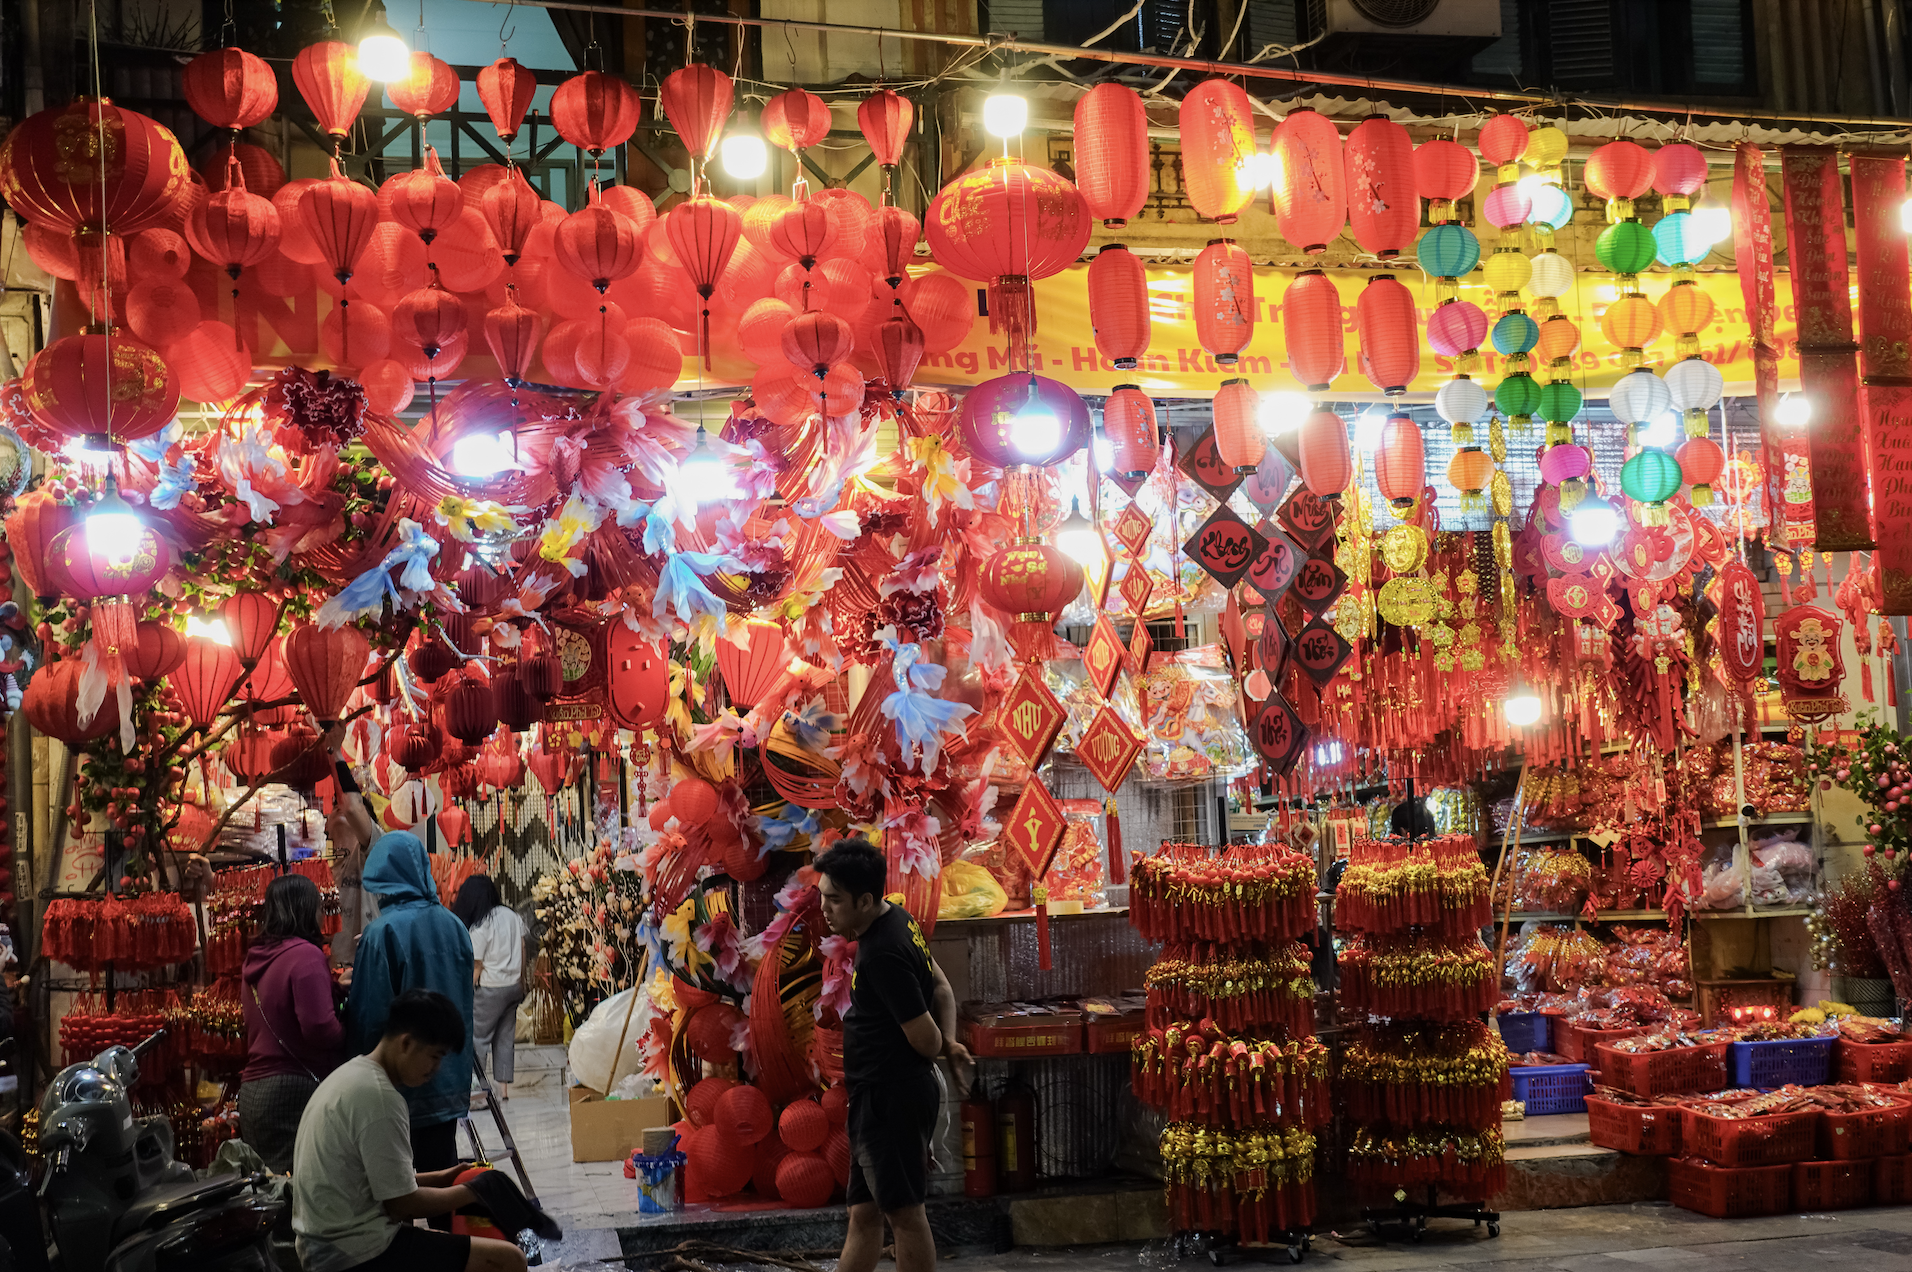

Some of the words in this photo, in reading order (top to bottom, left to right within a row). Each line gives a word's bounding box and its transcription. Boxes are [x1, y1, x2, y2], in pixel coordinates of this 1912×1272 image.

[1874, 431, 1912, 449] Xuâ
[1012, 699, 1043, 741] NHƯ
[1091, 726, 1121, 772] VƯỢNG
[1023, 806, 1043, 852] Ý
